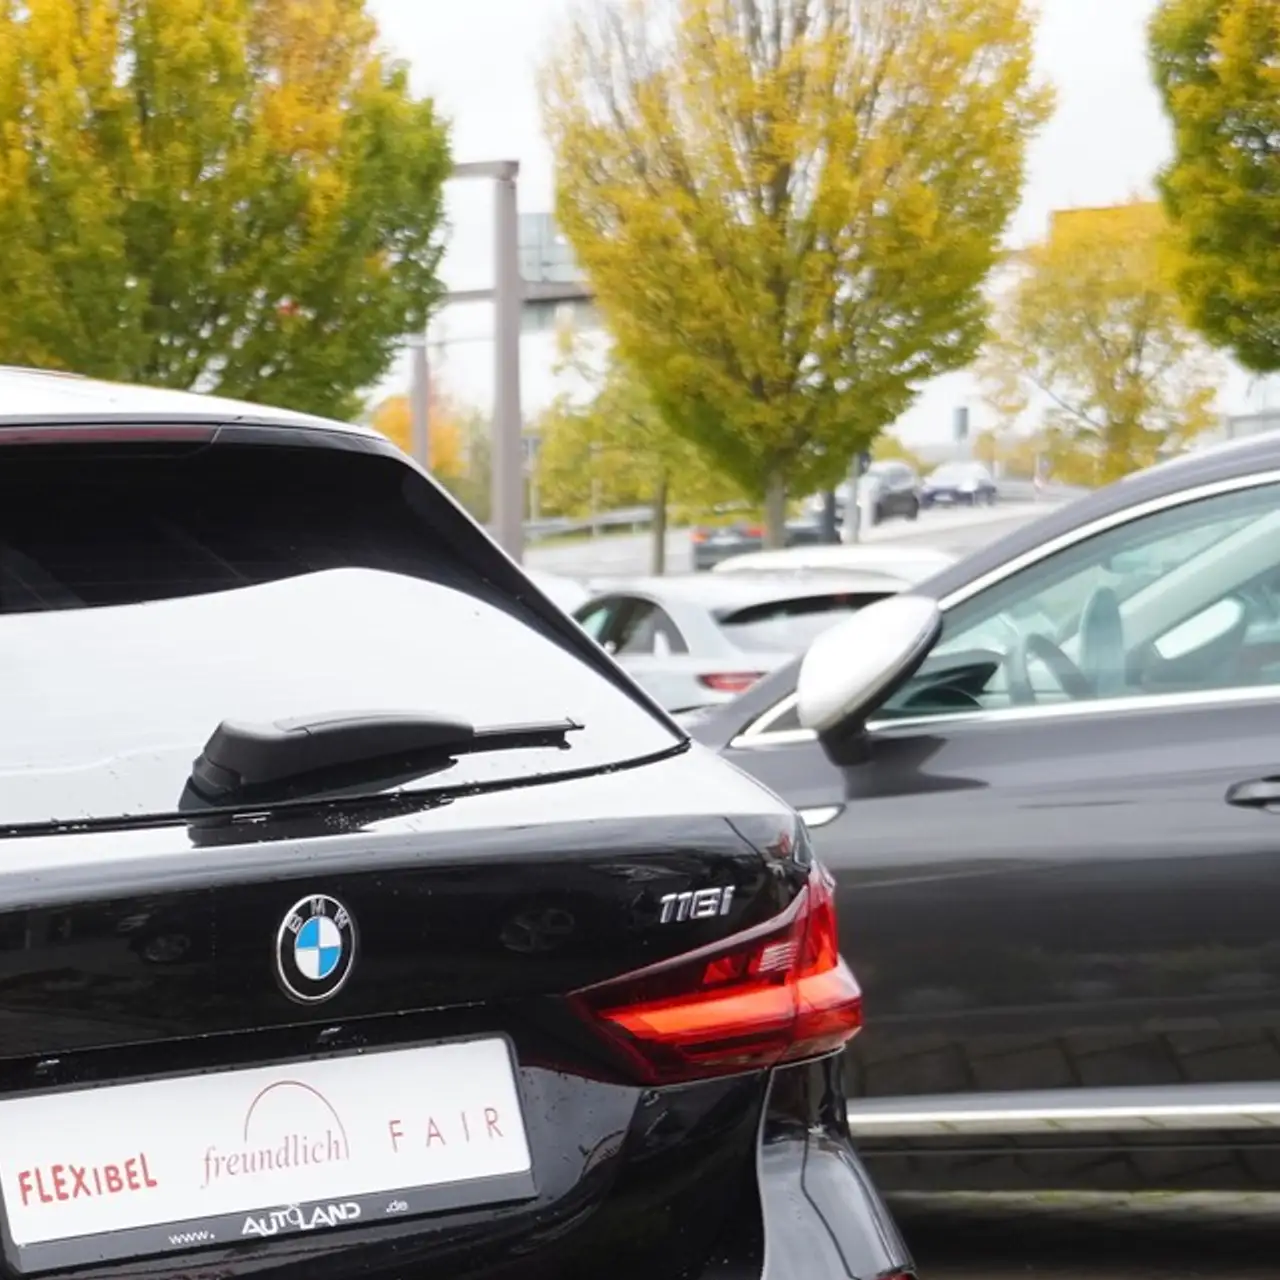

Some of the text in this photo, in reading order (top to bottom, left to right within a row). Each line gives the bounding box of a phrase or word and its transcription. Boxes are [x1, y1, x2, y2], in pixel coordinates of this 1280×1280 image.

[17, 1106, 505, 1206] FLEXIBEL freundlich FAIR
[168, 1230, 216, 1246] www.
[241, 1201, 362, 1237] AUTOLAND
